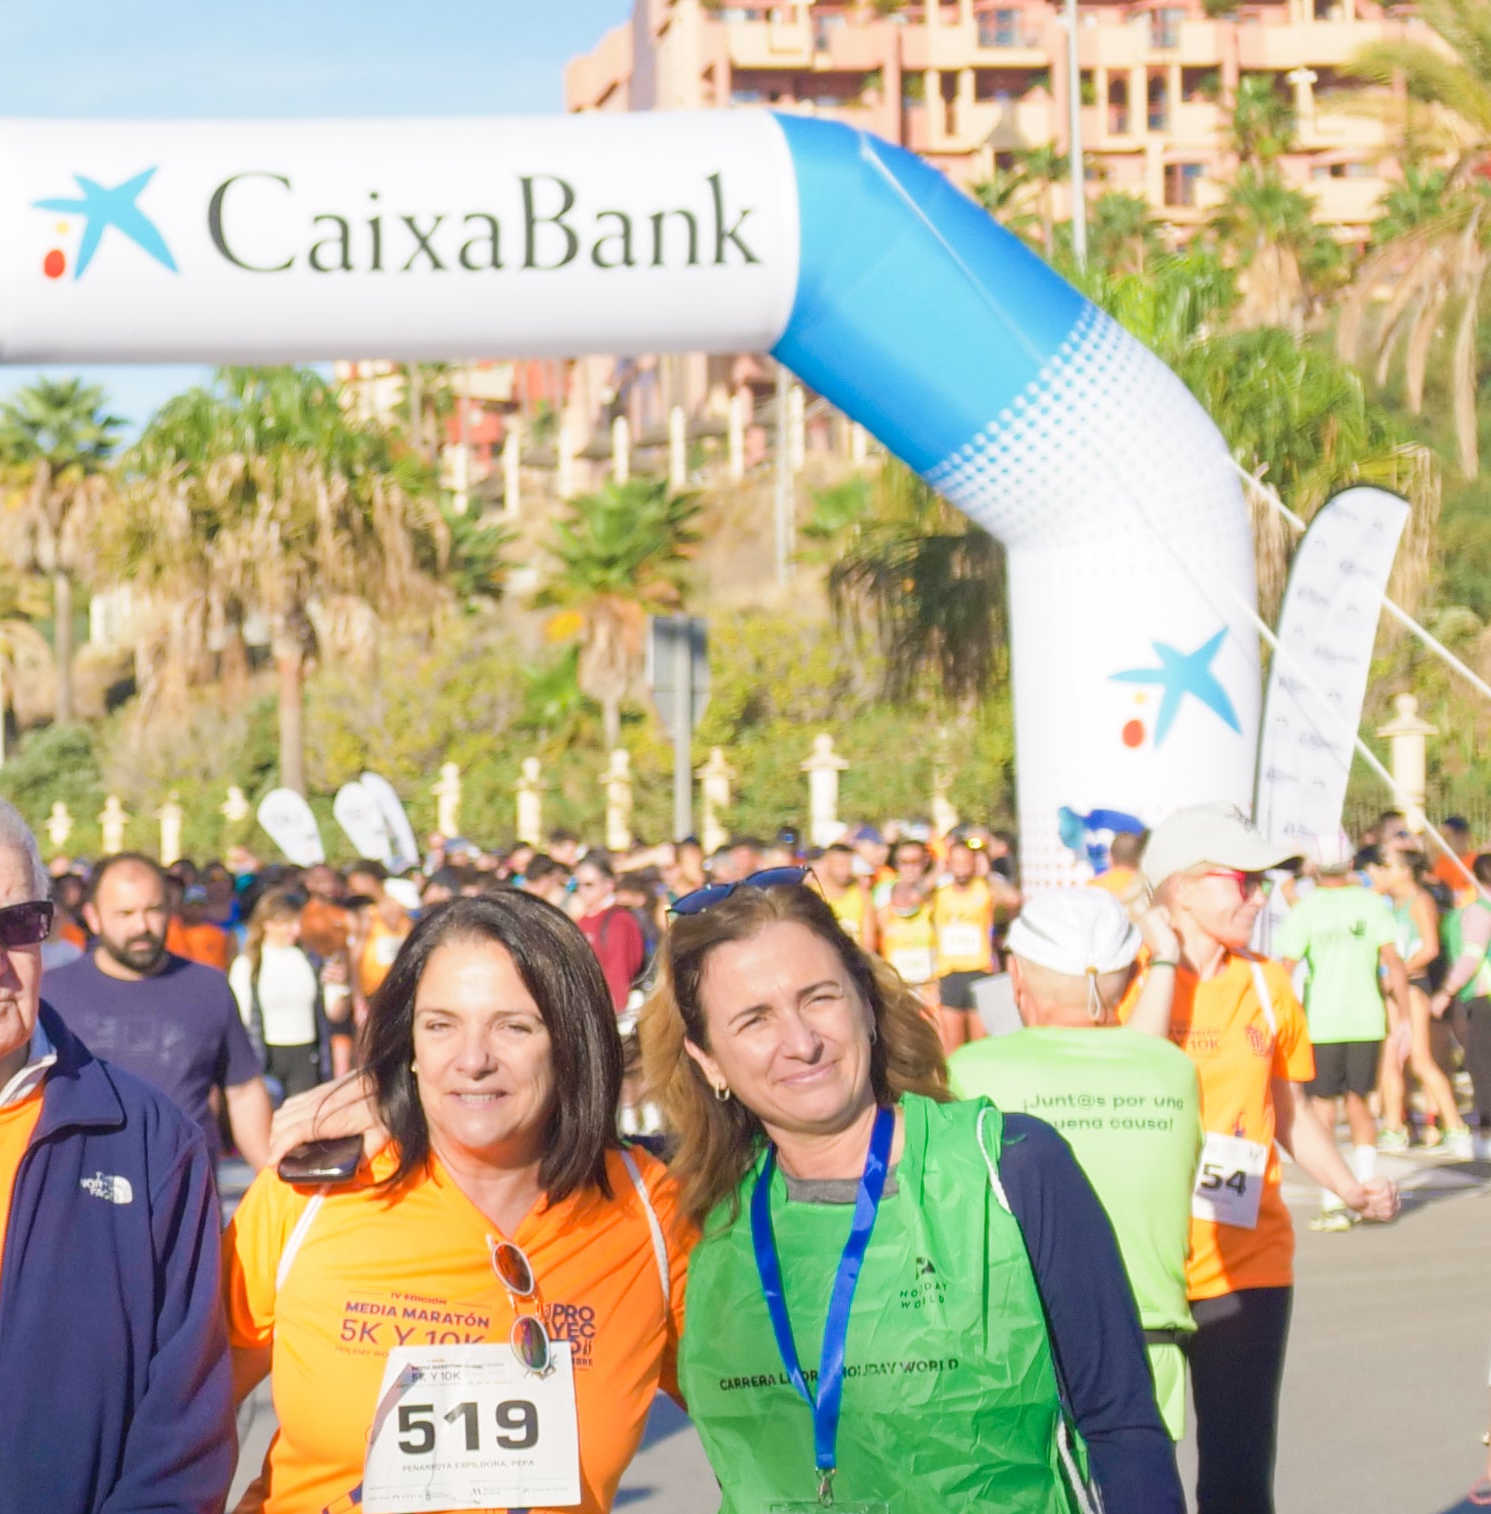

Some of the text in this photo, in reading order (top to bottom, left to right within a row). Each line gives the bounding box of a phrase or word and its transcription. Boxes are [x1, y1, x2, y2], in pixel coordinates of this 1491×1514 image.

[207, 170, 765, 275] CaixaBank
[1113, 1095, 1147, 1110] por
[1053, 1118, 1103, 1129] uena
[404, 1293, 447, 1305] EDICIÓN
[345, 1301, 490, 1328] MEDIA MARATÓN
[553, 1303, 596, 1322] PRO
[340, 1318, 382, 1345] 5K
[393, 1324, 415, 1346] Y
[551, 1320, 596, 1339] YEC
[440, 1371, 461, 1381] 10K
[719, 1374, 776, 1391] CARRERA
[898, 1359, 959, 1374] WORLD
[397, 1400, 539, 1455] 519
